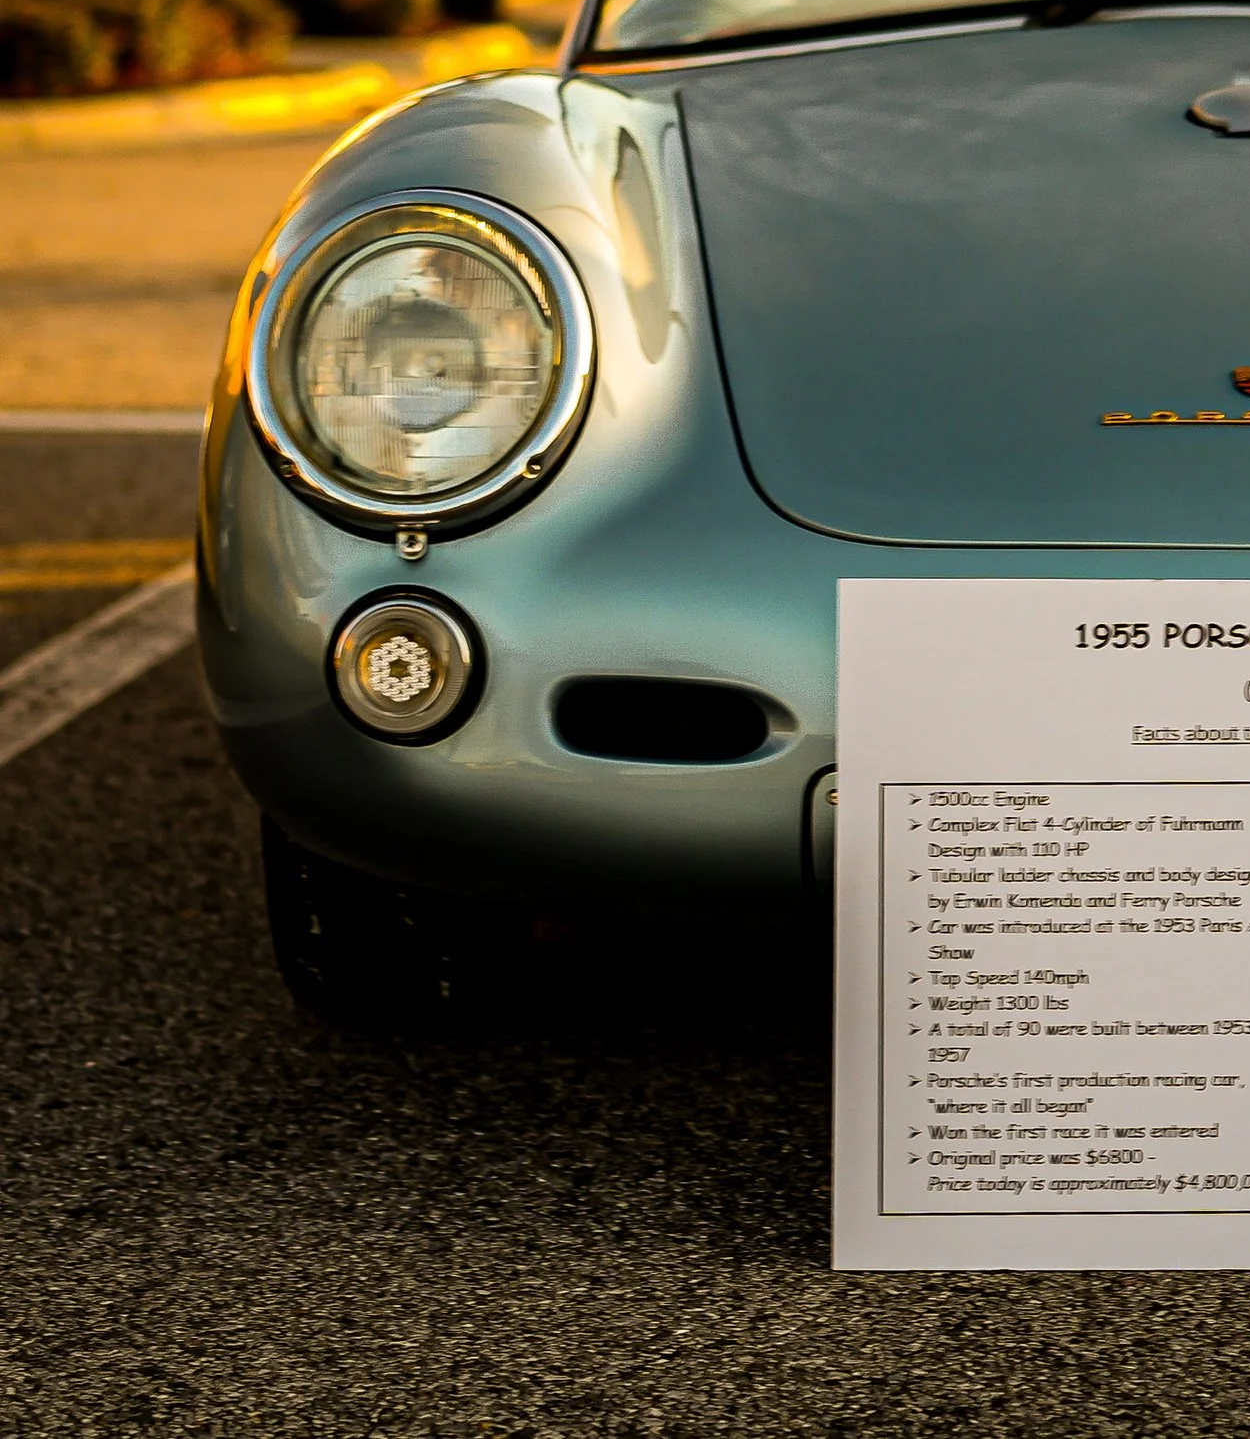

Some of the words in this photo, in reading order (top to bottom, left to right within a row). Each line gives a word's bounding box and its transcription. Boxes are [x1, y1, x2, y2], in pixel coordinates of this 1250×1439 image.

[1074, 622, 1151, 650] 1955
[1131, 725, 1181, 742] Facts
[1182, 723, 1241, 742] about
[927, 791, 991, 807] 1500cc
[992, 790, 1052, 811] Engine
[926, 816, 1001, 837] Complex
[1002, 816, 1040, 833] Flat
[1041, 816, 1134, 837] 4-Cylinder
[1134, 815, 1158, 833] of
[927, 842, 987, 862] Design
[987, 841, 1029, 858] with
[1031, 841, 1062, 857] 110
[1063, 841, 1090, 858] HP
[927, 867, 995, 884] Tubular
[997, 867, 1055, 883] ladder
[1056, 866, 1121, 883] chassis
[1122, 866, 1156, 883] and
[1157, 866, 1203, 887] body
[927, 893, 951, 914] by
[952, 892, 1003, 909] Erwin
[1083, 892, 1118, 908] and
[1119, 892, 1172, 913] Ferry
[1172, 891, 1243, 908] Porsche
[926, 919, 960, 935] Car
[960, 922, 995, 935] was
[997, 917, 1093, 934] introduced
[1093, 919, 1116, 934] at
[1117, 917, 1151, 934] the
[1152, 917, 1196, 934] 1953
[1198, 917, 1244, 933] Paris
[927, 944, 976, 960] Show
[926, 970, 962, 990] Top
[963, 969, 1020, 990] Speed
[1022, 968, 1090, 990] 140mph
[927, 995, 993, 1016] Weight
[995, 995, 1040, 1011] 1300
[1042, 994, 1070, 1011] lbs
[927, 1022, 943, 1037] A
[945, 1020, 990, 1037] total
[991, 1020, 1014, 1038] of
[1016, 1020, 1042, 1037] 90
[1043, 1025, 1089, 1037] were
[1090, 1020, 1133, 1037] built
[1134, 1020, 1210, 1036] between
[927, 1046, 972, 1063] 1957
[926, 1072, 1009, 1089] Porsche's
[1010, 1072, 1055, 1089] first
[1056, 1071, 1151, 1093] production
[1152, 1072, 1208, 1092] racing
[991, 1098, 1008, 1114] it
[1009, 1097, 1033, 1114] all
[926, 1124, 968, 1140] Won
[969, 1123, 1003, 1140] the
[1004, 1123, 1049, 1141] first
[1050, 1127, 1092, 1140] race
[1093, 1123, 1111, 1139] it
[1112, 1126, 1147, 1139] was
[1148, 1122, 1220, 1139] entered
[926, 1149, 997, 1171] Original
[999, 1150, 1046, 1170] price
[1046, 1153, 1082, 1165] was
[1083, 1147, 1145, 1168] $6800
[926, 1176, 973, 1192] Price
[974, 1175, 1028, 1196] today
[1028, 1176, 1046, 1191] is
[1046, 1174, 1172, 1196] approximately
